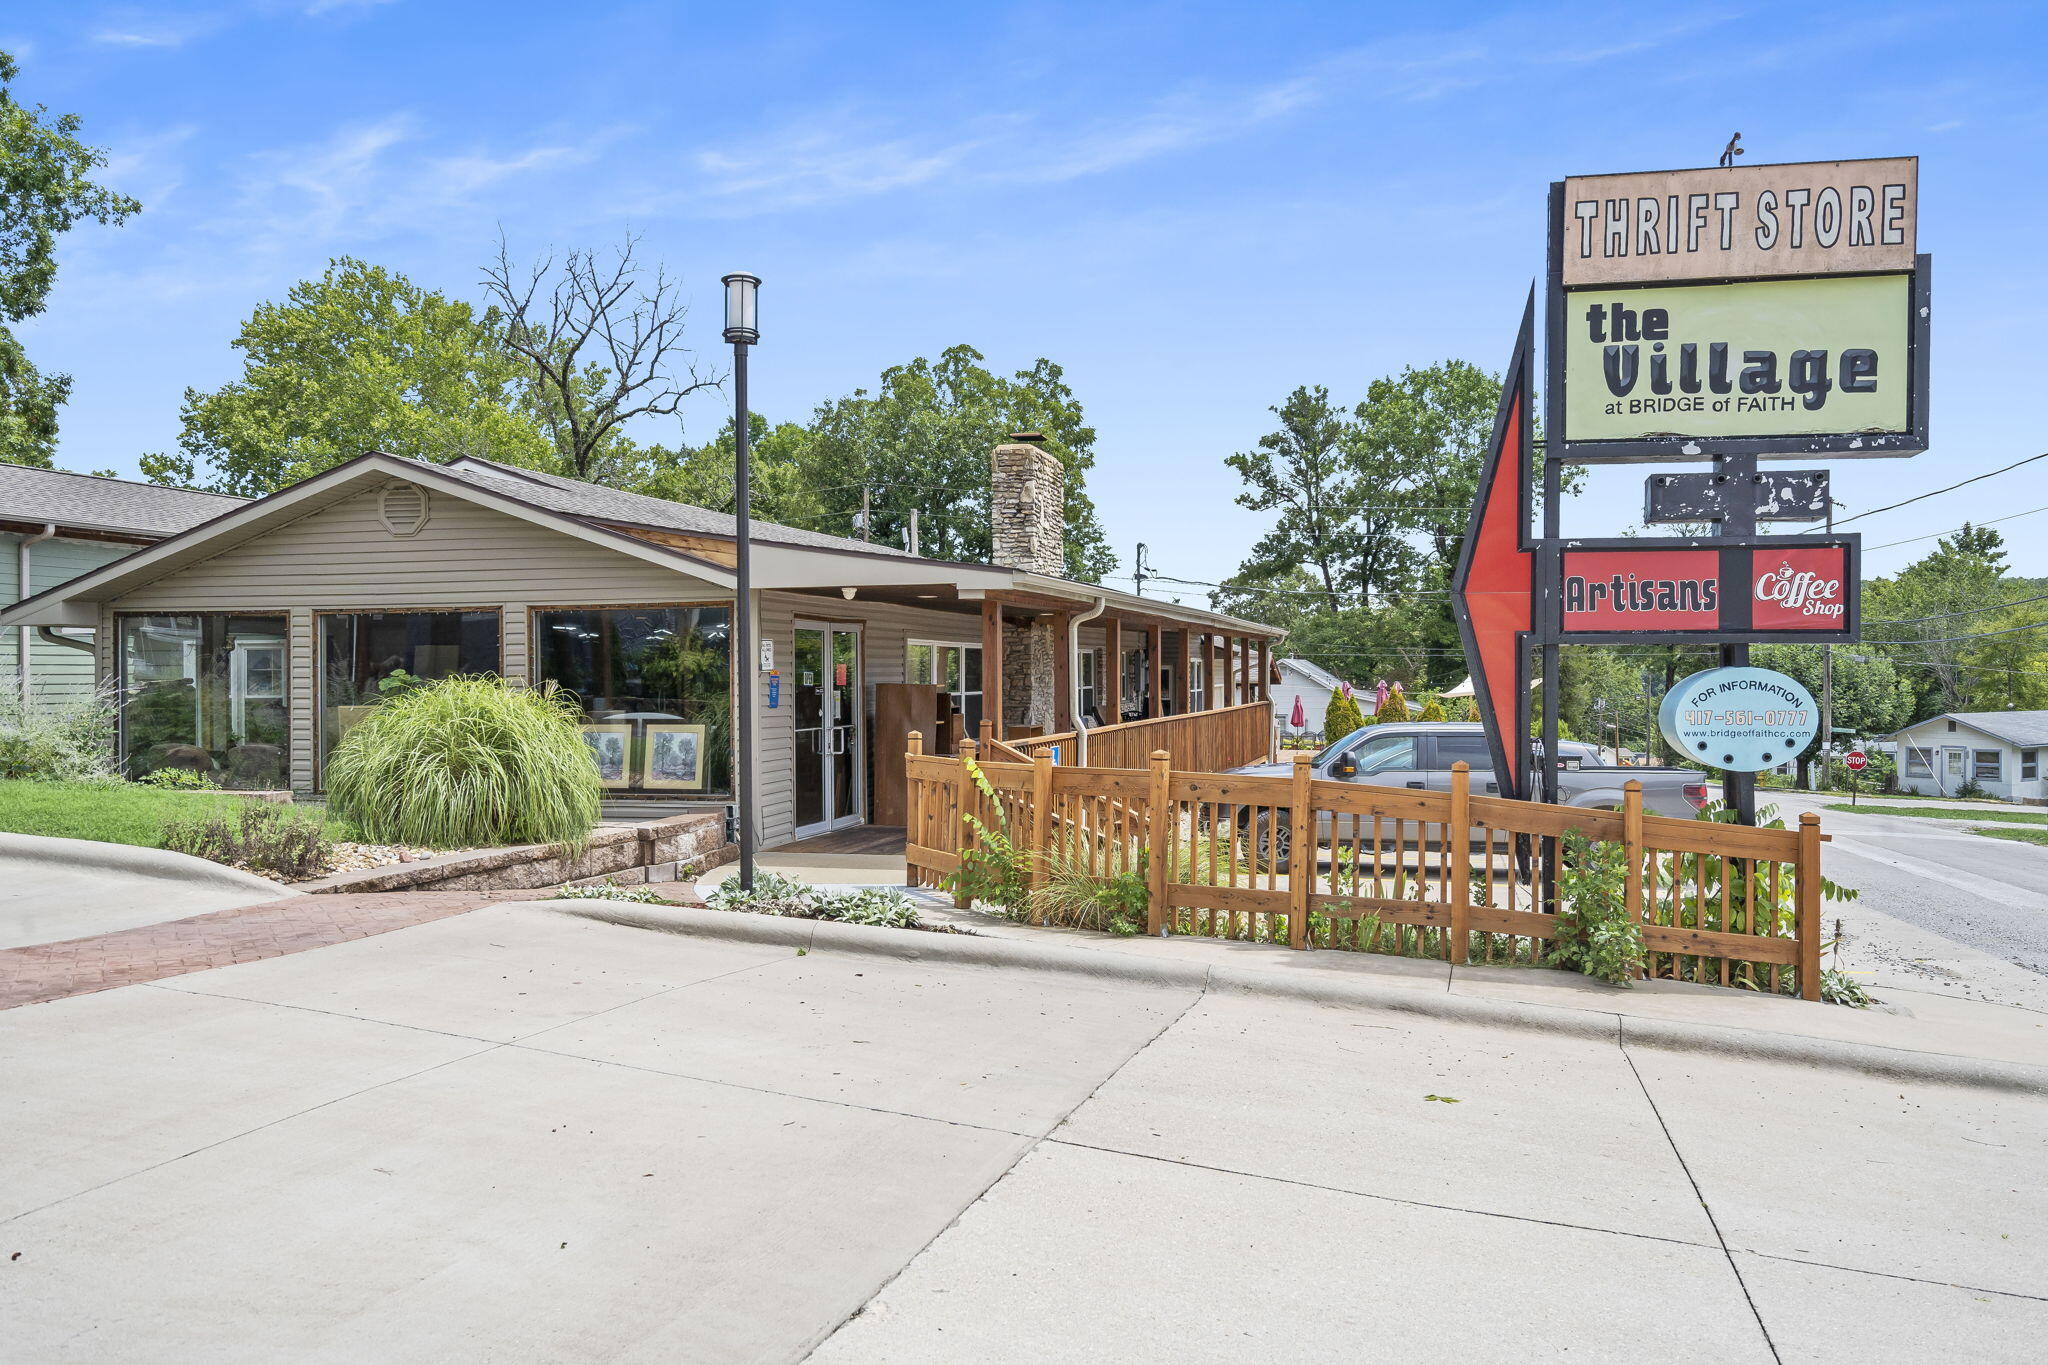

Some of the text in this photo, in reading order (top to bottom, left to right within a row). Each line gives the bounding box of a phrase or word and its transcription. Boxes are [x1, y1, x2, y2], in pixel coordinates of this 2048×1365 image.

[1575, 184, 1905, 259] THRIFT STORE
[1586, 303, 1669, 342] the
[1603, 342, 1878, 411] Village
[1605, 397, 1795, 415] at BRIDGE of FAITH
[1565, 573, 1718, 613] Artisans
[1755, 571, 1840, 608] Coffee
[1803, 600, 1844, 619] Shop
[1691, 680, 1803, 709] FOR INFORMATION
[1684, 710, 1808, 726] 417-561-0777
[1682, 729, 1811, 739] www.bridgeoffaithcc.com
[1847, 756, 1866, 765] STOP
